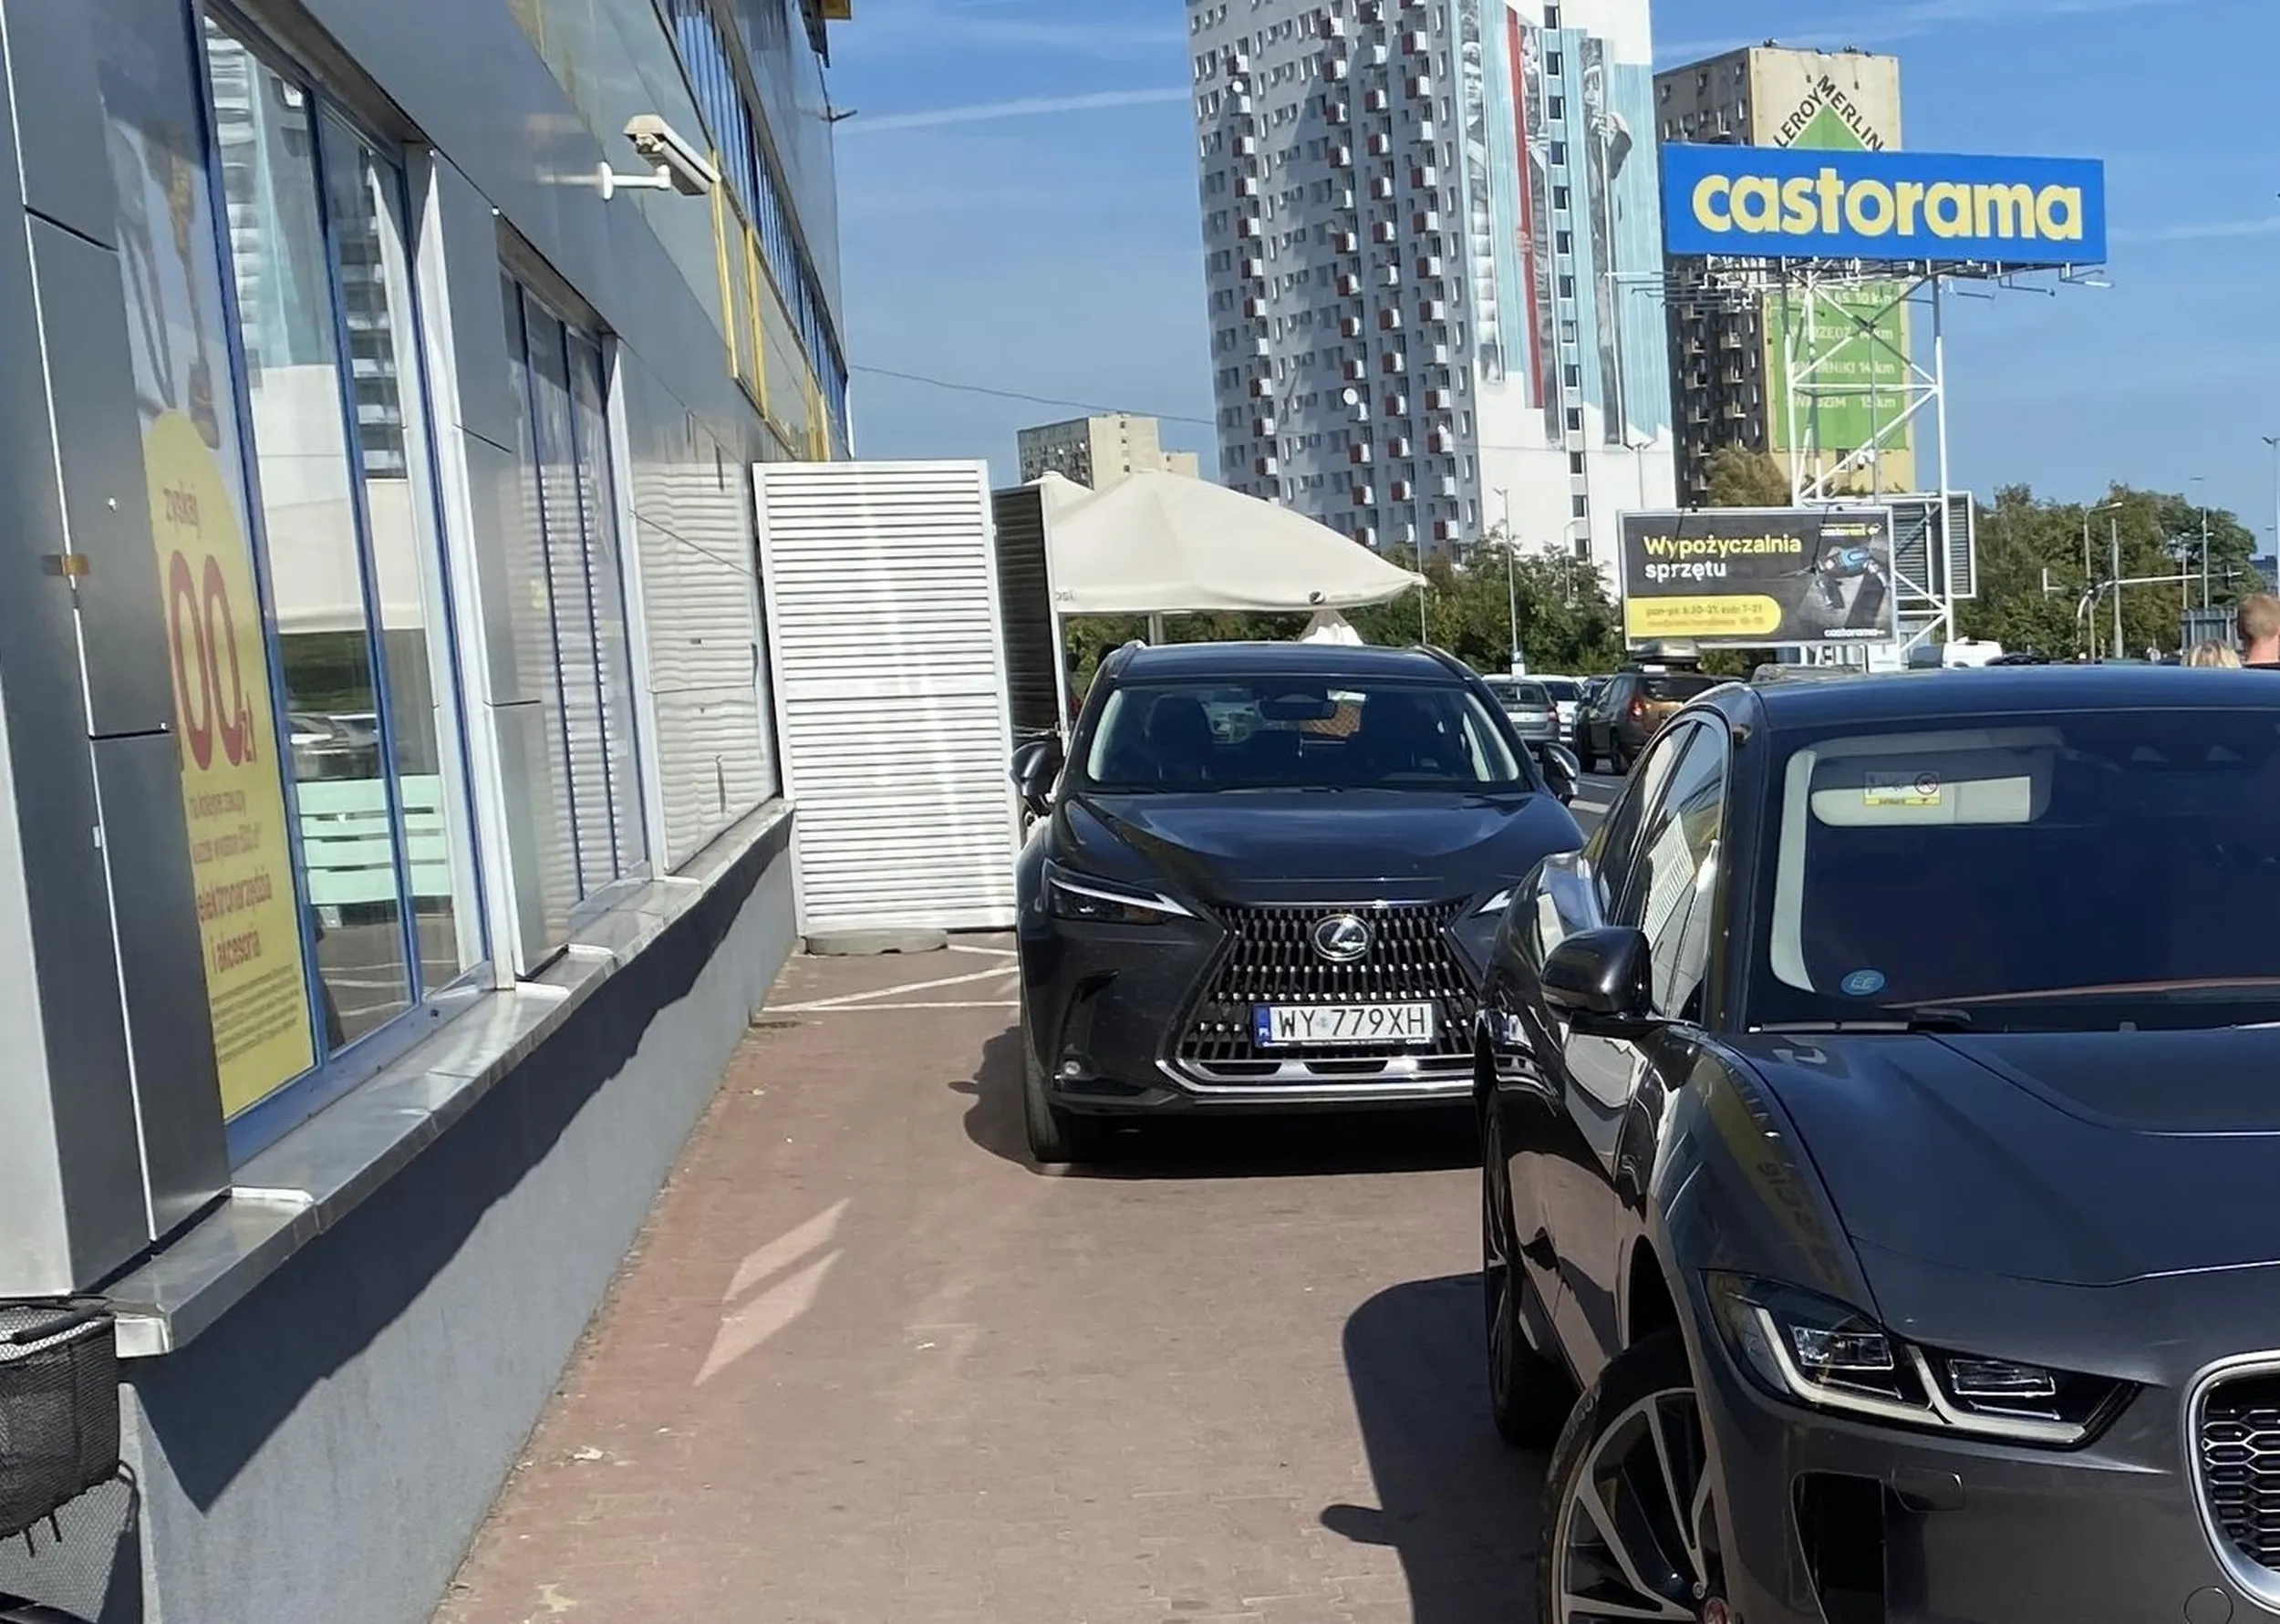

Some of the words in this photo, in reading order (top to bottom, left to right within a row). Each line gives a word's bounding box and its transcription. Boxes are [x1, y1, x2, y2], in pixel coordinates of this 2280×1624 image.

[1773, 88, 1822, 148] LEROY
[1817, 75, 1884, 150] MERLIN
[1693, 168, 2083, 241] castorama
[1643, 533, 1802, 559] Wypożyczalnia
[1644, 560, 1726, 584] sprzętu
[1279, 1009, 1316, 1038] WY
[1331, 1006, 1425, 1037] 779XH
